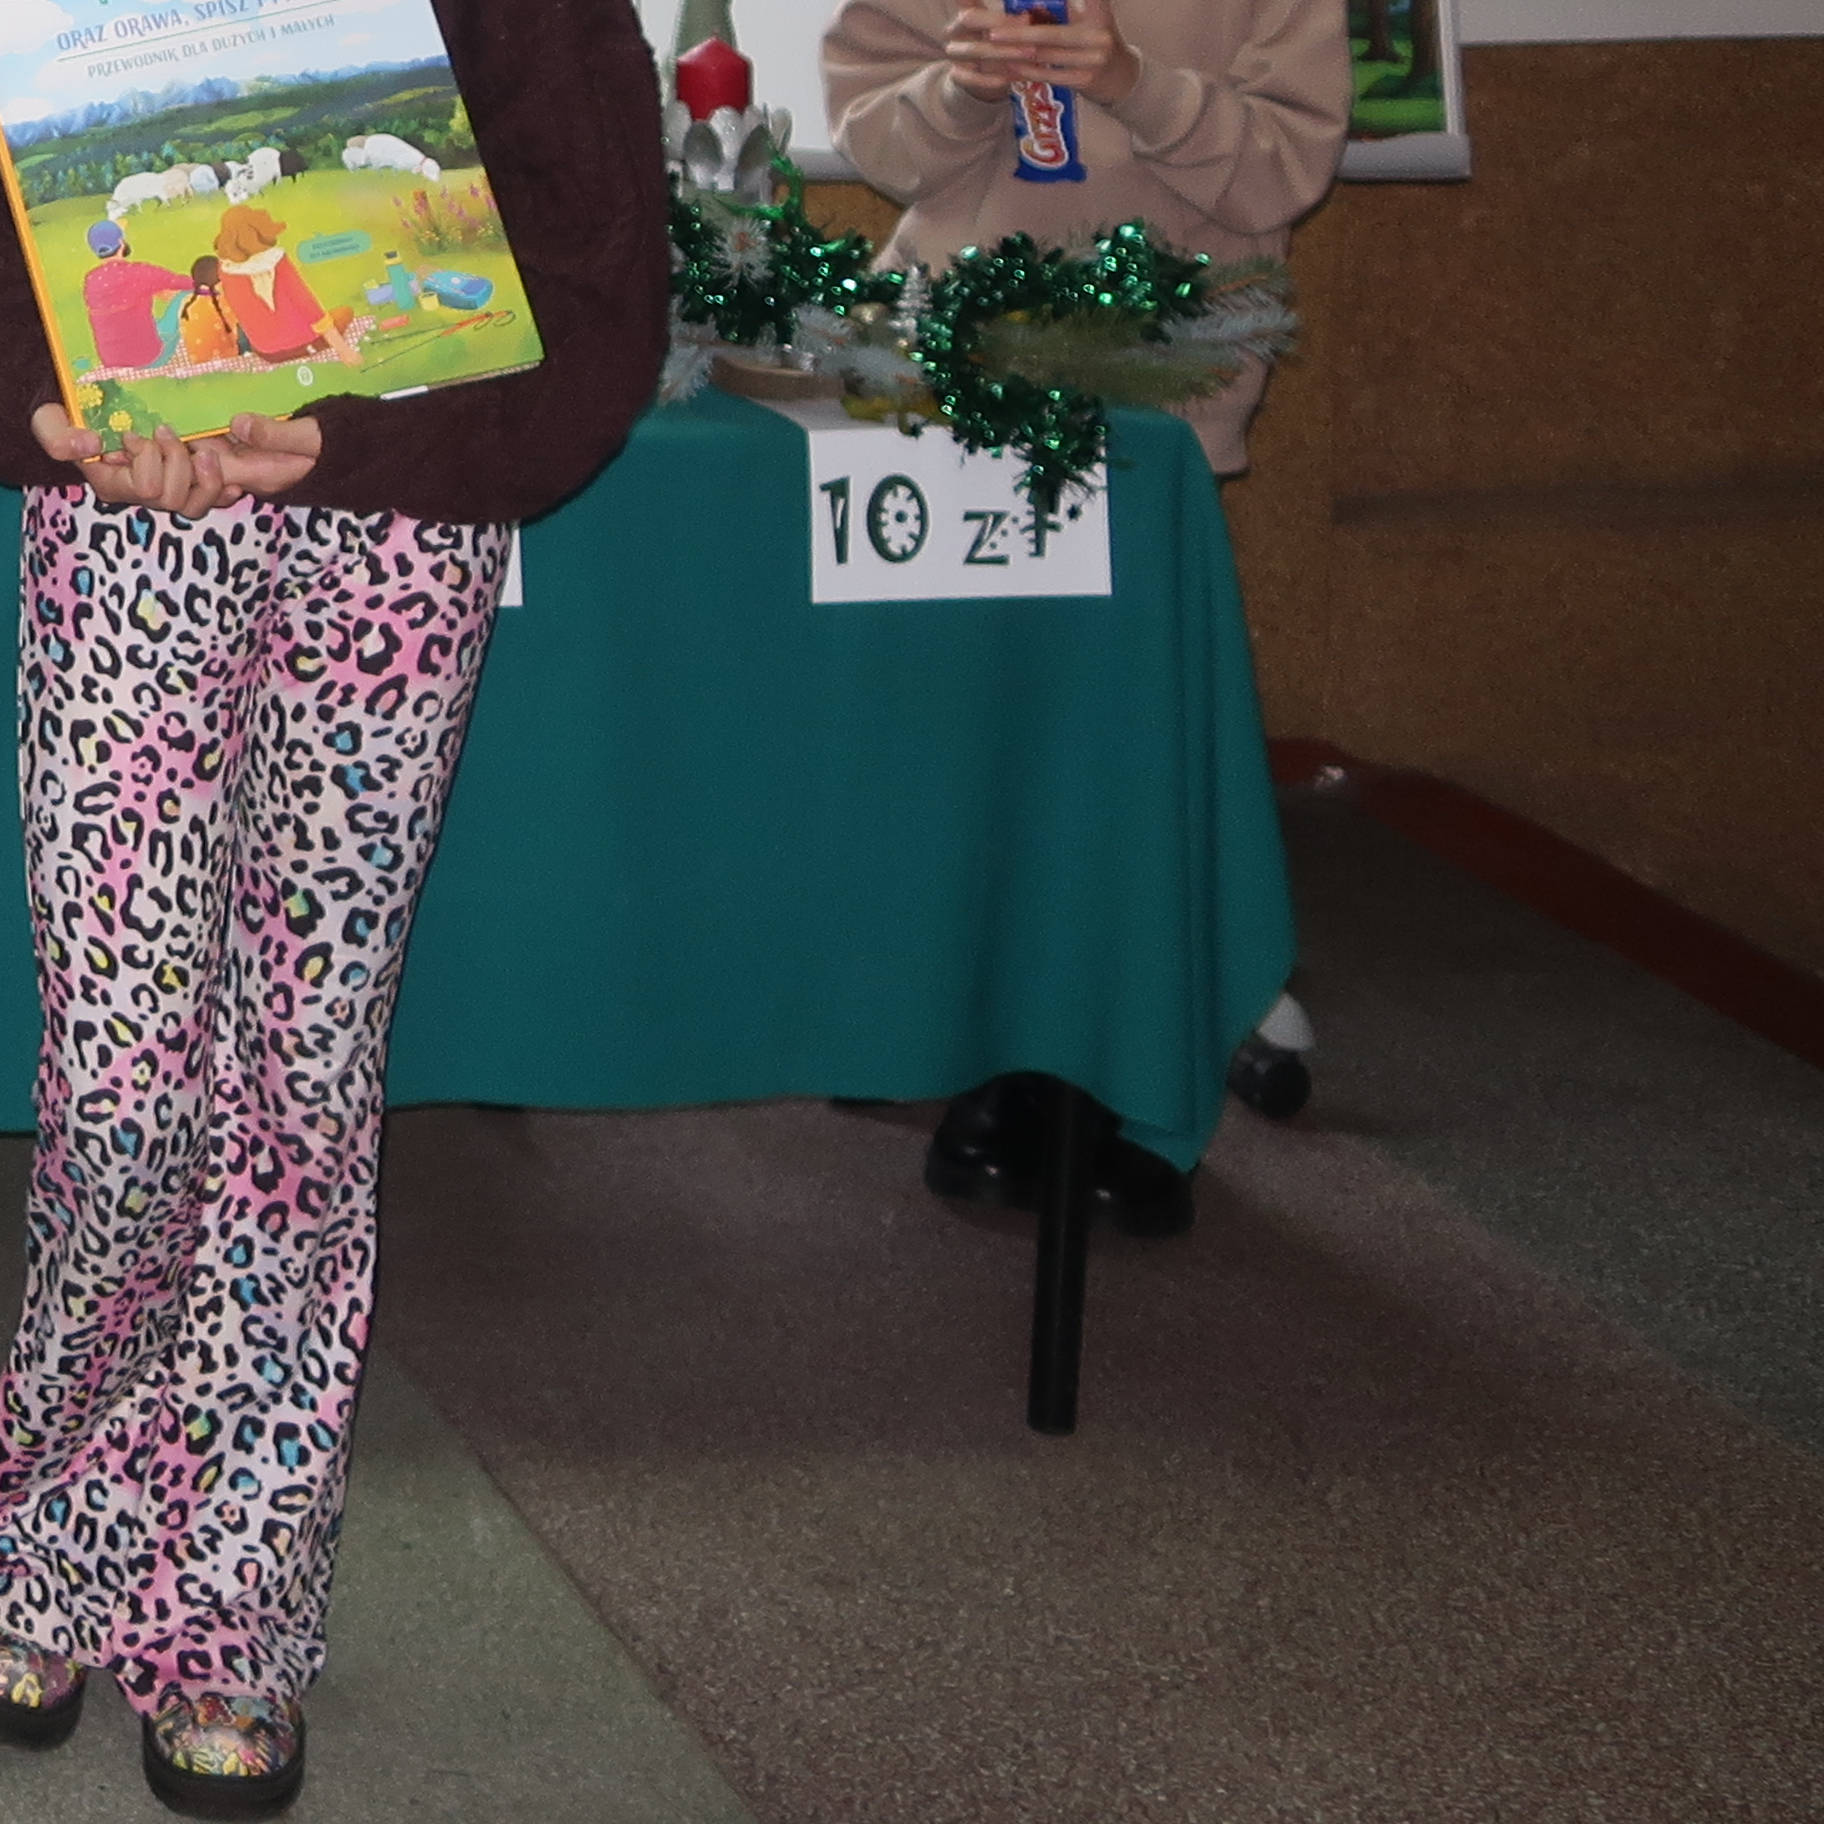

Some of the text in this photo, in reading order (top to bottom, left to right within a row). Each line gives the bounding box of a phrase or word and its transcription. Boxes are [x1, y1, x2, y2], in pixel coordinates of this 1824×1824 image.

[56, 25, 109, 52] ORAZ
[114, 9, 190, 39] ORAWA,
[87, 49, 181, 78] PRZEWODNIK
[182, 40, 209, 59] DLA
[819, 473, 930, 567] 10
